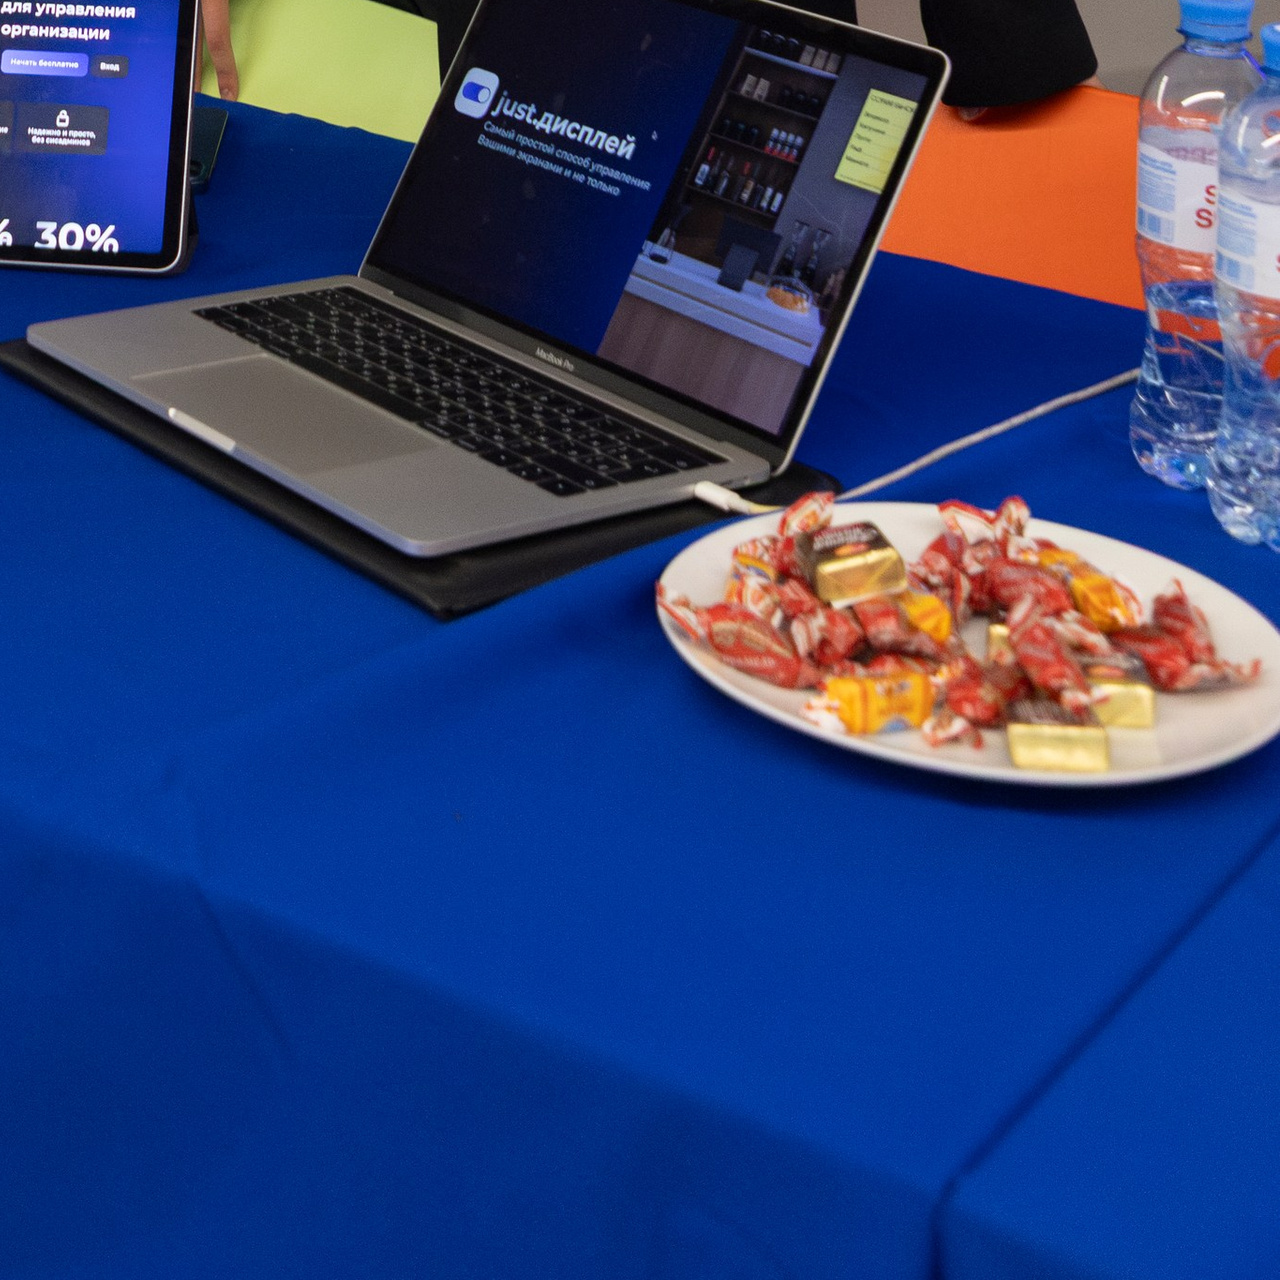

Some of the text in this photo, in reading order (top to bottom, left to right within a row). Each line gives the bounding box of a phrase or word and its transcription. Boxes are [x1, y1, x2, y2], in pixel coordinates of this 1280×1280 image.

[1, 1, 32, 14] для
[35, 2, 136, 19] управления
[1, 24, 110, 41] организации
[100, 61, 120, 72] Вход
[490, 90, 637, 161] just.дисплей
[477, 133, 517, 157] Вашими
[517, 150, 563, 175] экранами
[572, 170, 586, 184] не
[586, 176, 621, 196] только
[483, 120, 652, 191] Самый простой способ управления
[34, 220, 119, 254] 30%
